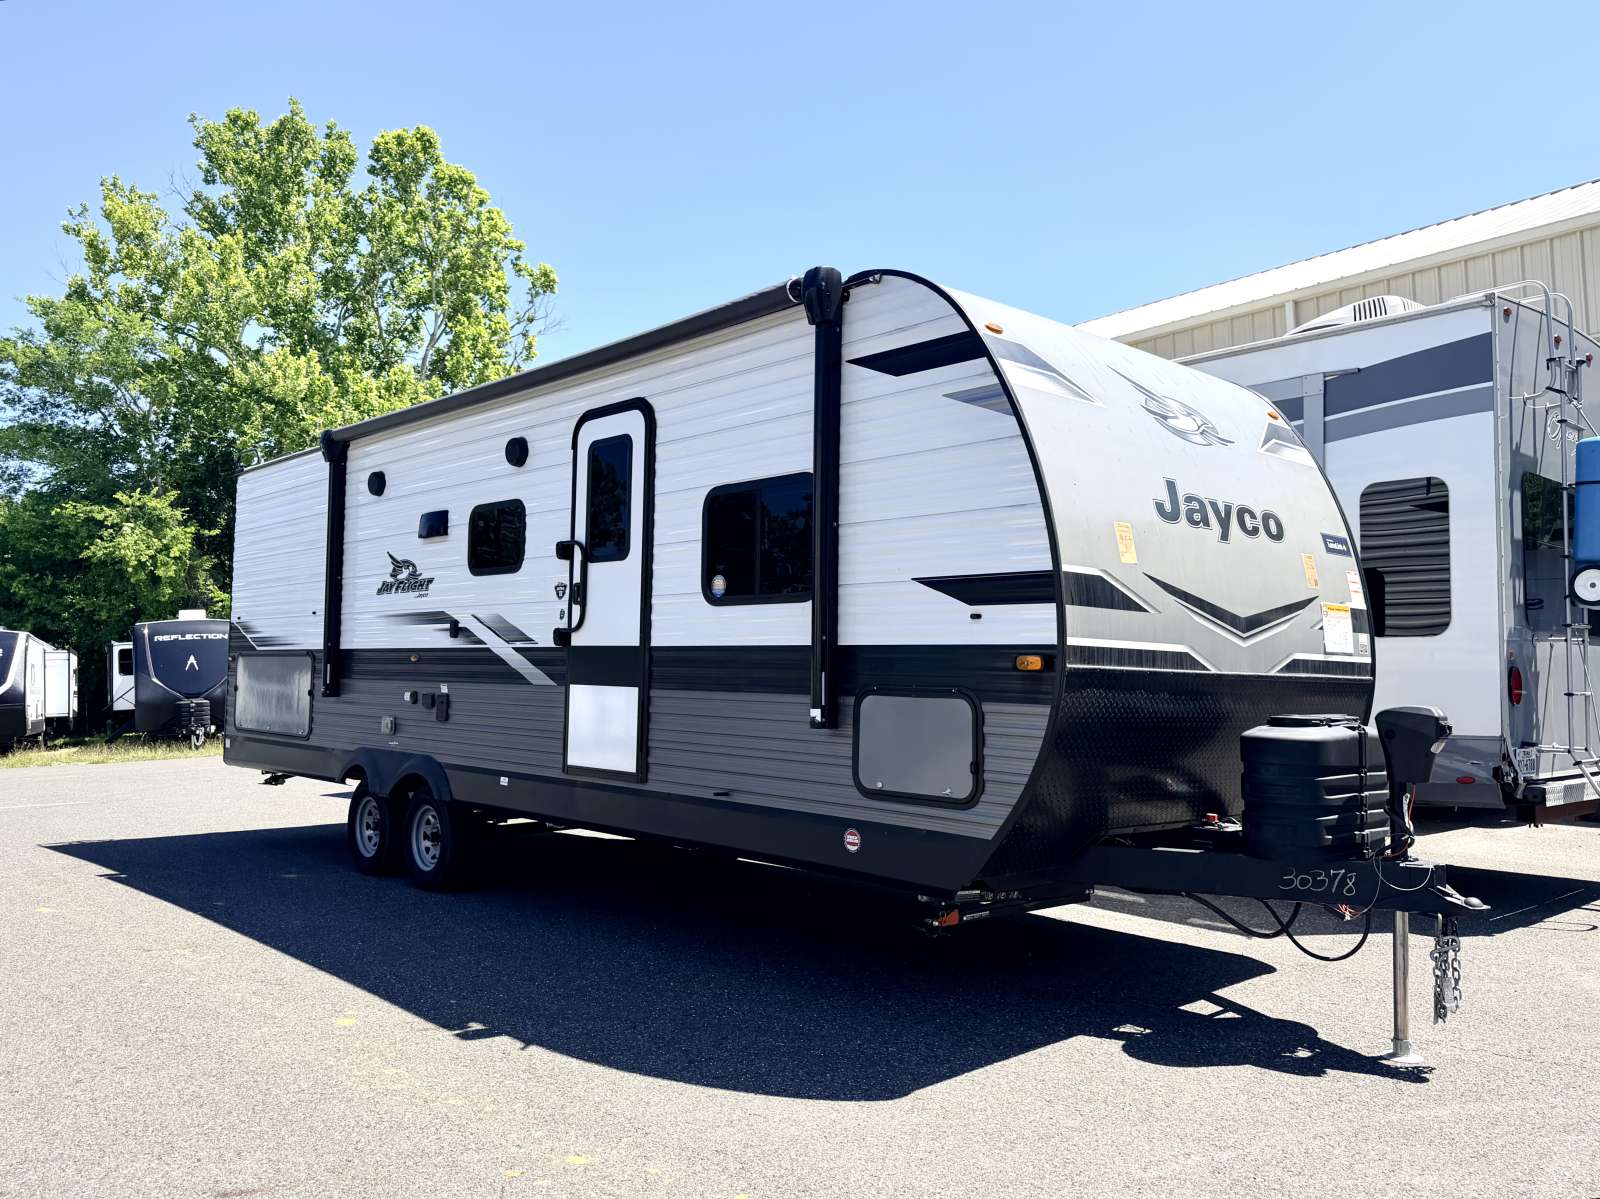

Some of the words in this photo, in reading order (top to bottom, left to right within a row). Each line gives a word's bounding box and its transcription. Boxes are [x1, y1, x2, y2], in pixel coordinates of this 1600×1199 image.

[1152, 476, 1286, 544] Jayco
[376, 580, 398, 596] JAY
[394, 577, 435, 594] FLIGHT
[154, 633, 229, 642] REFLECTION
[1277, 866, 1357, 896] 30378
